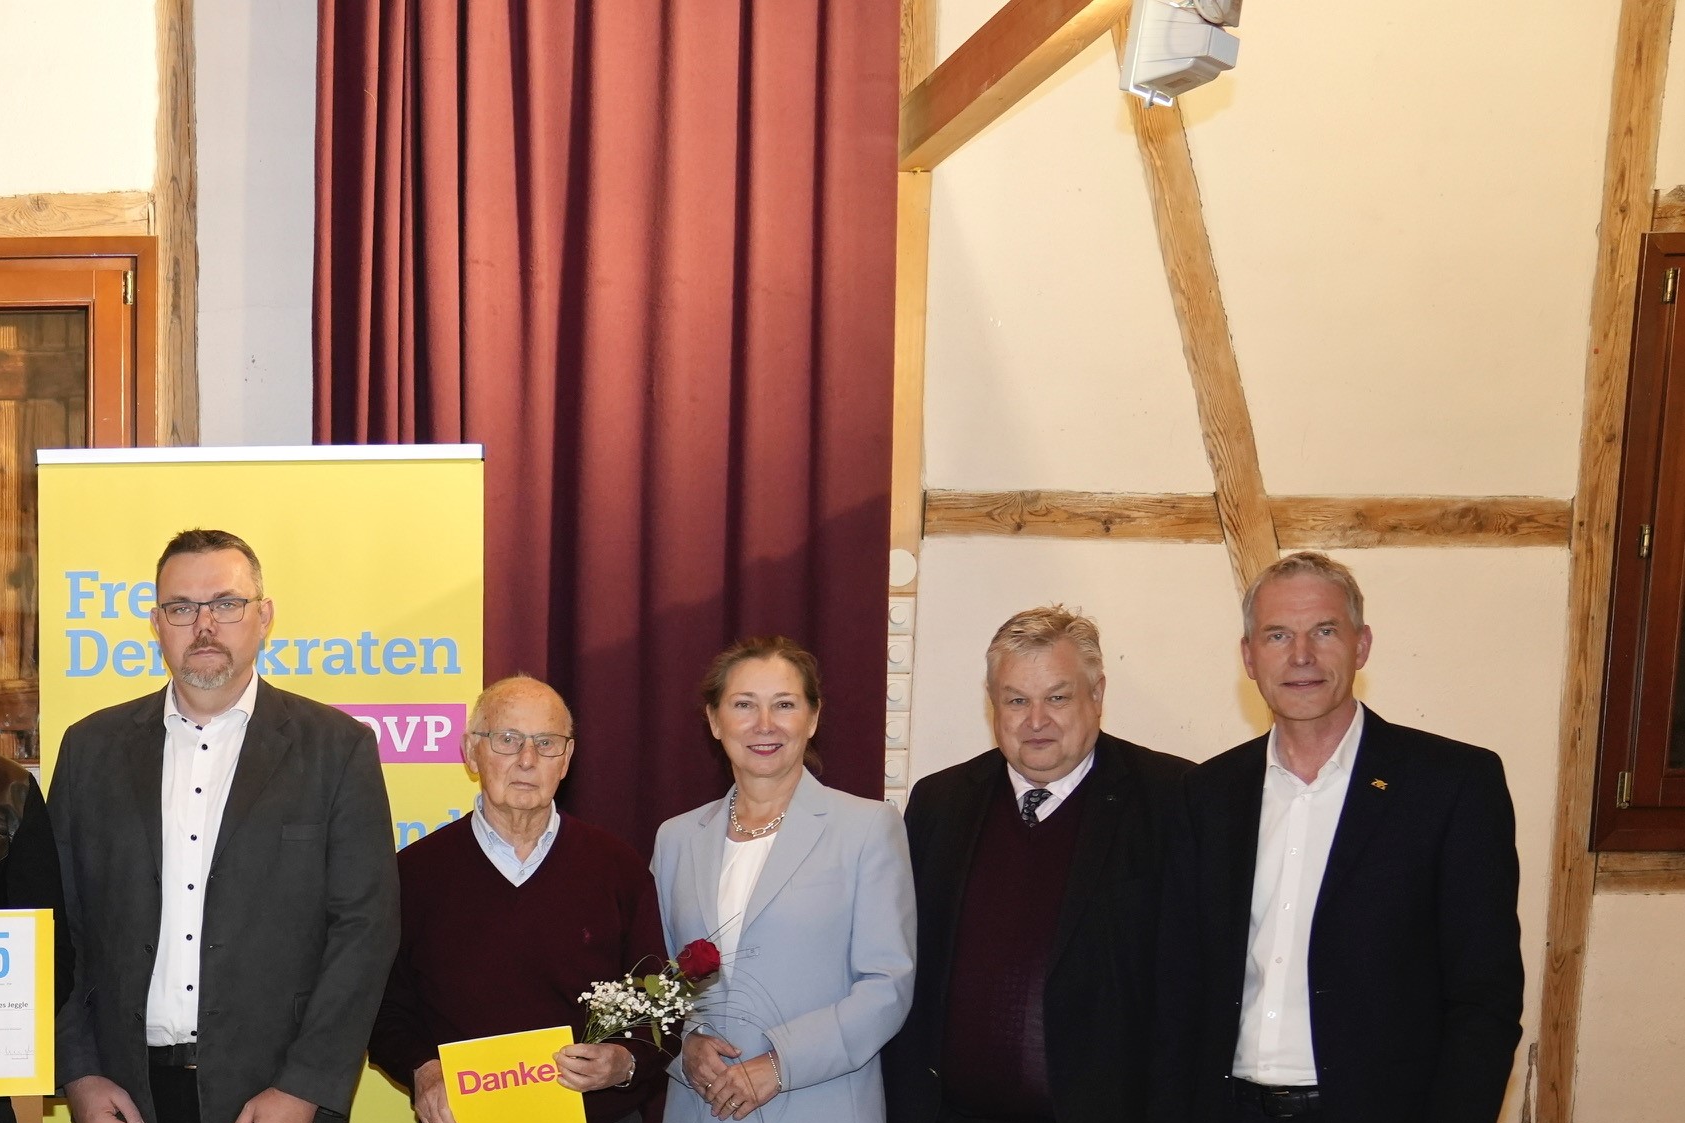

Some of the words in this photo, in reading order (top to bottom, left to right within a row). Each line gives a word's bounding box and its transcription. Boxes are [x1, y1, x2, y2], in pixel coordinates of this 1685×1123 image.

[64, 571, 158, 619] Fre
[7, 1001, 29, 1010] Jeggle
[456, 1061, 563, 1096] Danke
